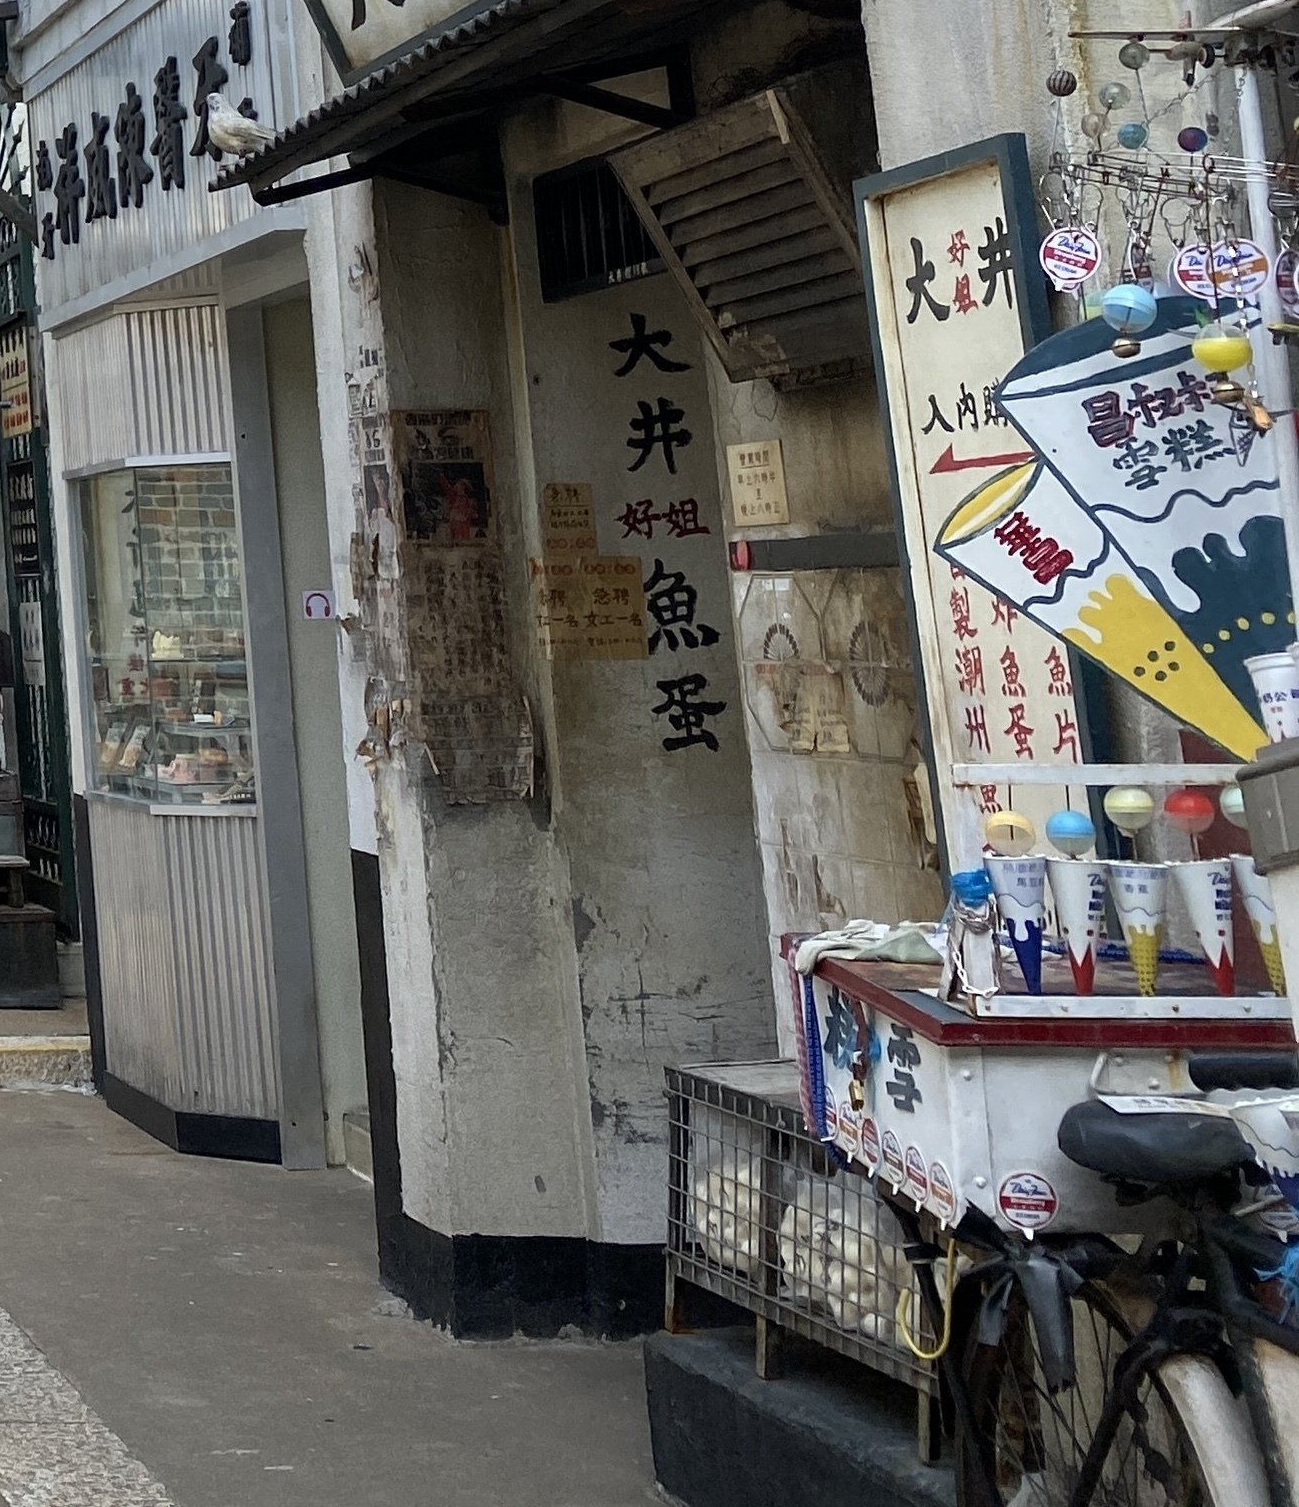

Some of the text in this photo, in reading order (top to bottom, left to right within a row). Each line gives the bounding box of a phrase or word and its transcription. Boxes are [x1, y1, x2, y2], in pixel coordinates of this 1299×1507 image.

[608, 312, 693, 475] 大井
[614, 497, 711, 541] 好姐
[641, 557, 728, 754] 魚蛋
